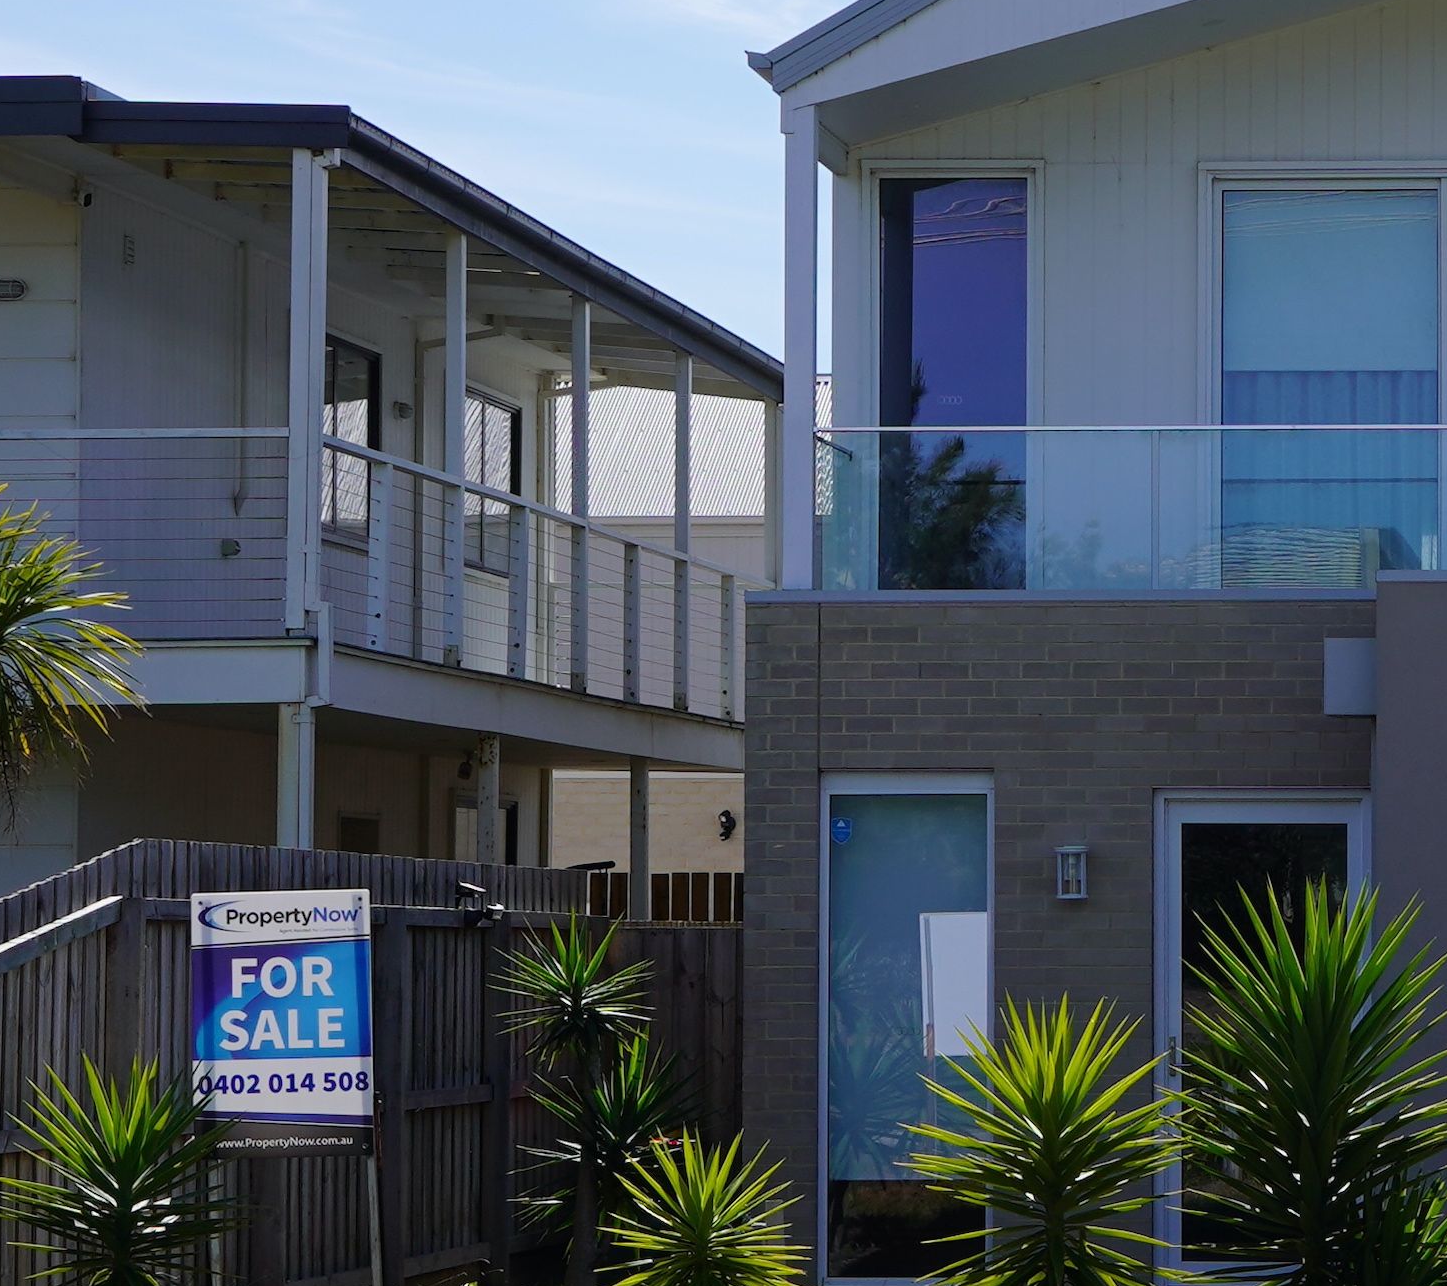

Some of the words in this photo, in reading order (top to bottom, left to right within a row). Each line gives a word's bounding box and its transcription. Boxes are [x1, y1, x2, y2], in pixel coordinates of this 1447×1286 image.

[226, 906, 359, 927] PropertyNow
[231, 956, 335, 999] FOR
[219, 1008, 345, 1051] SALE
[199, 1074, 261, 1095] 0402
[268, 1073, 316, 1093] 014
[323, 1071, 369, 1092] 508
[216, 1136, 354, 1150] www.PropertyNow.com.au
